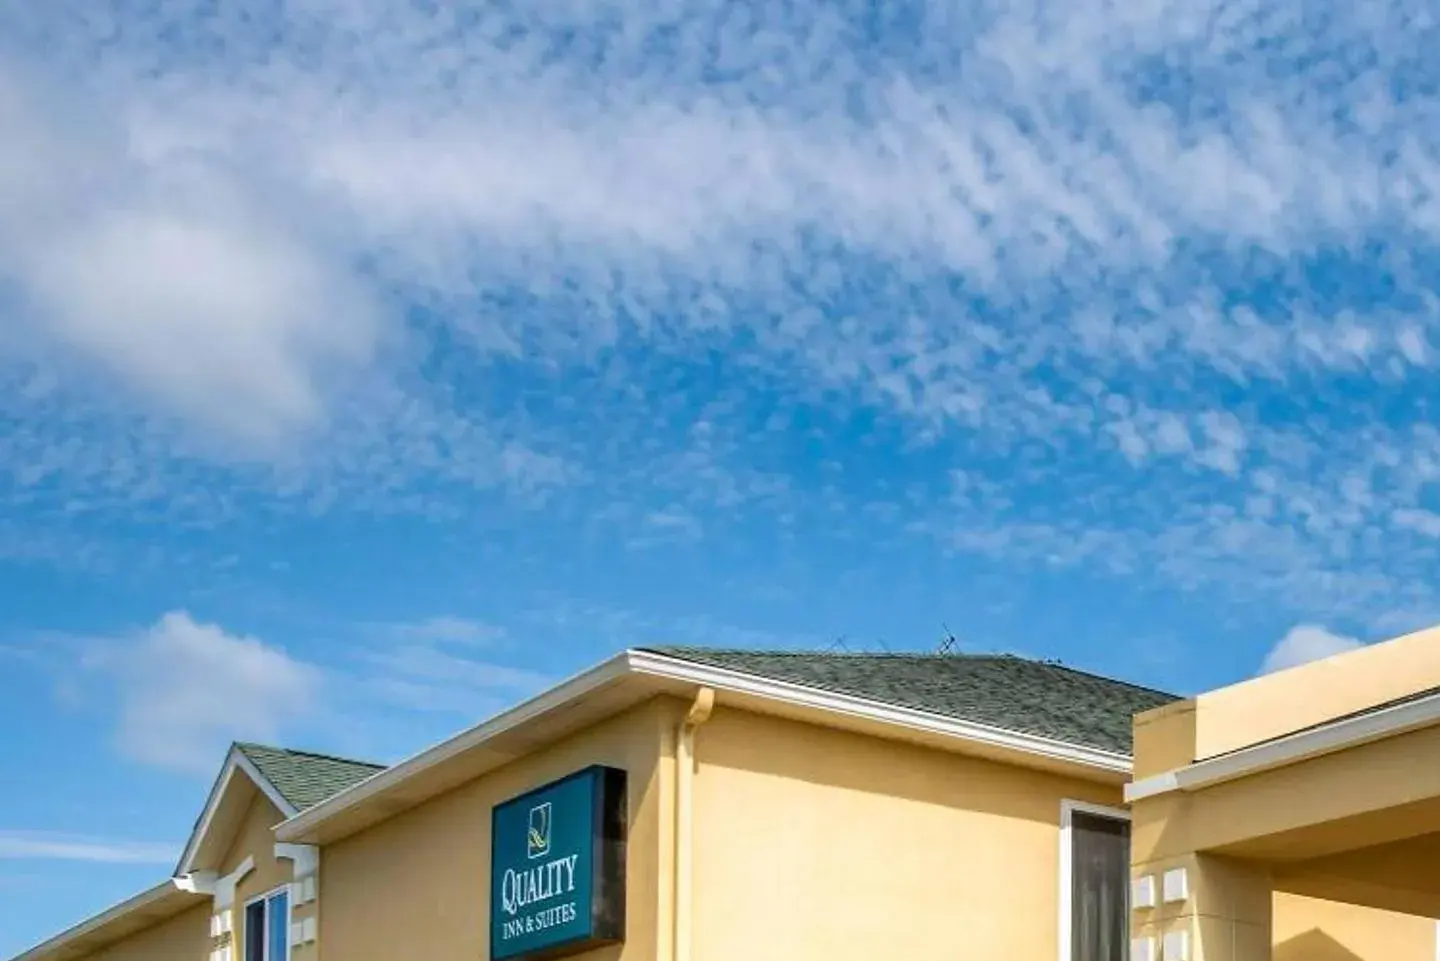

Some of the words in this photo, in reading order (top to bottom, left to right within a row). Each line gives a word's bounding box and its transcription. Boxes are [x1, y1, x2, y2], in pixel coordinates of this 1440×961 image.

[502, 854, 578, 915] QUALITY
[502, 918, 524, 940] INN
[525, 915, 535, 933] &
[535, 902, 577, 930] SUITES
